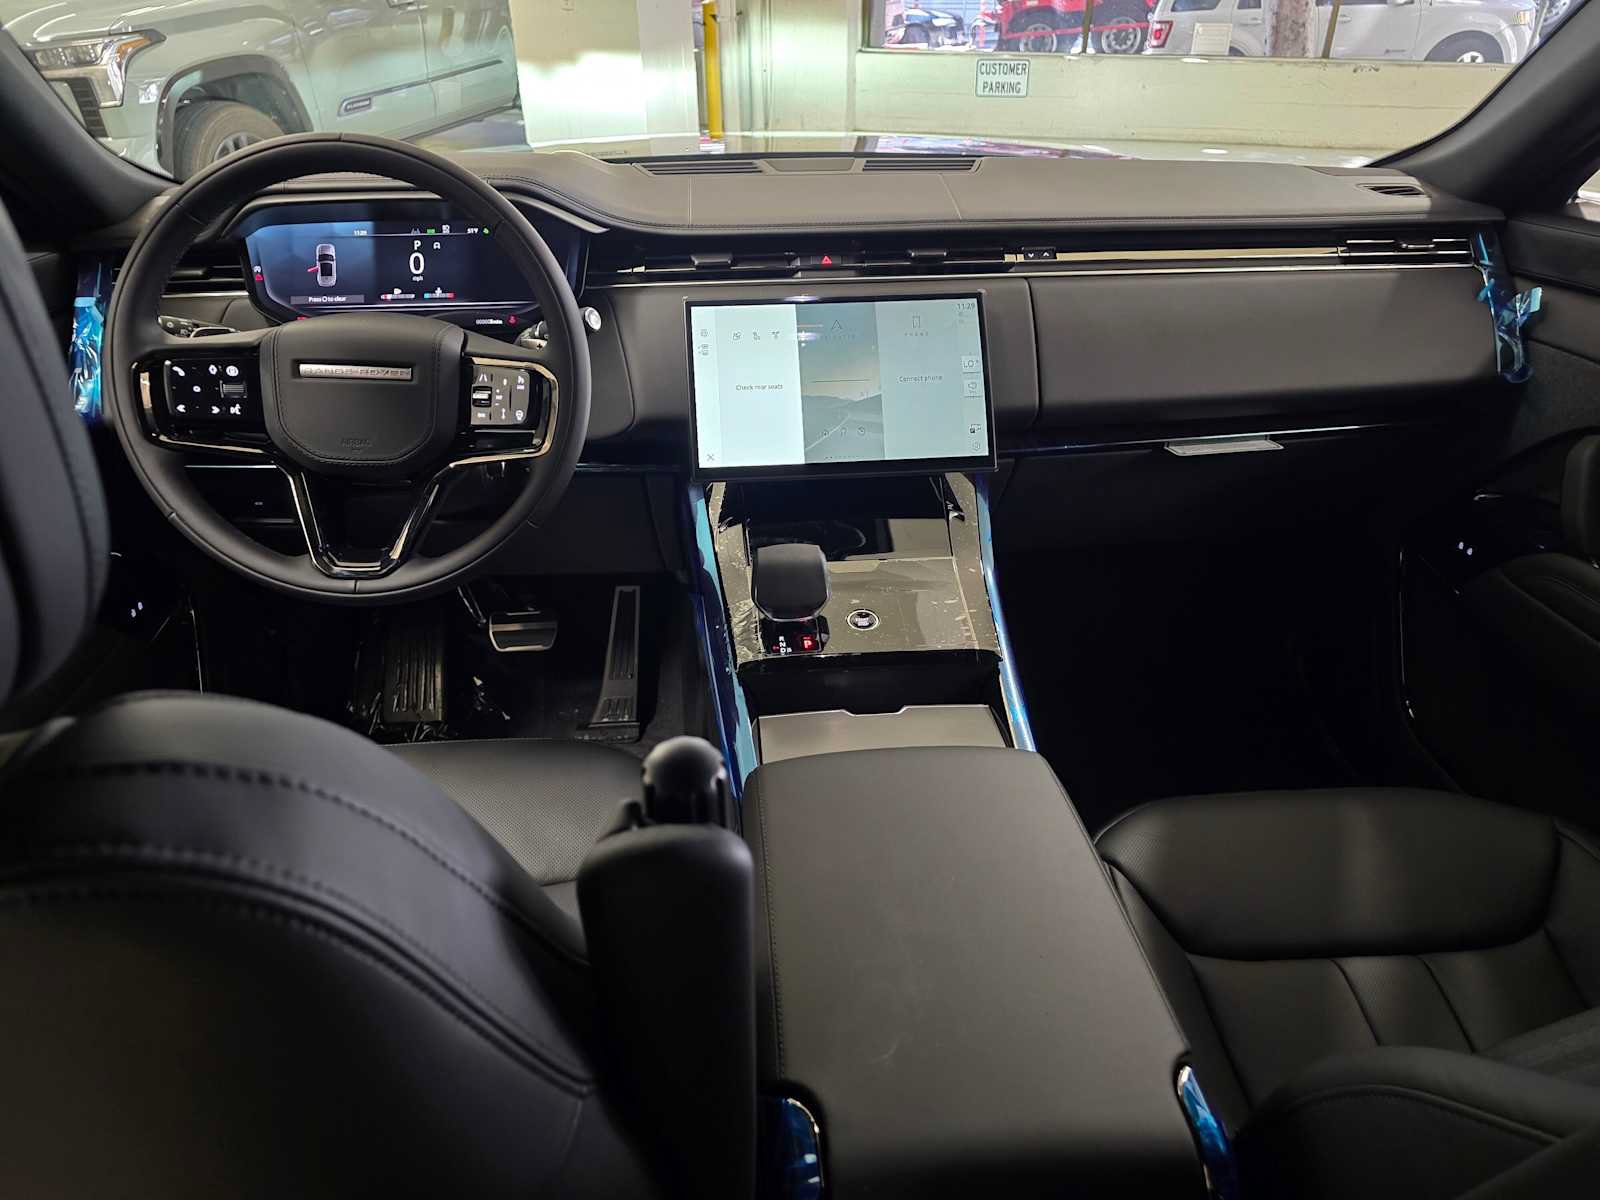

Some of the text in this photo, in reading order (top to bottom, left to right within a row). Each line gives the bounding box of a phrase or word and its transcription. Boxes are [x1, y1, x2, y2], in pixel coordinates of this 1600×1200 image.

[979, 62, 1027, 75] CUSTOMER
[982, 81, 1022, 94] PARKING
[413, 240, 421, 250] P
[409, 252, 425, 275] 0
[924, 375, 943, 384] phone
[803, 640, 812, 649] P
